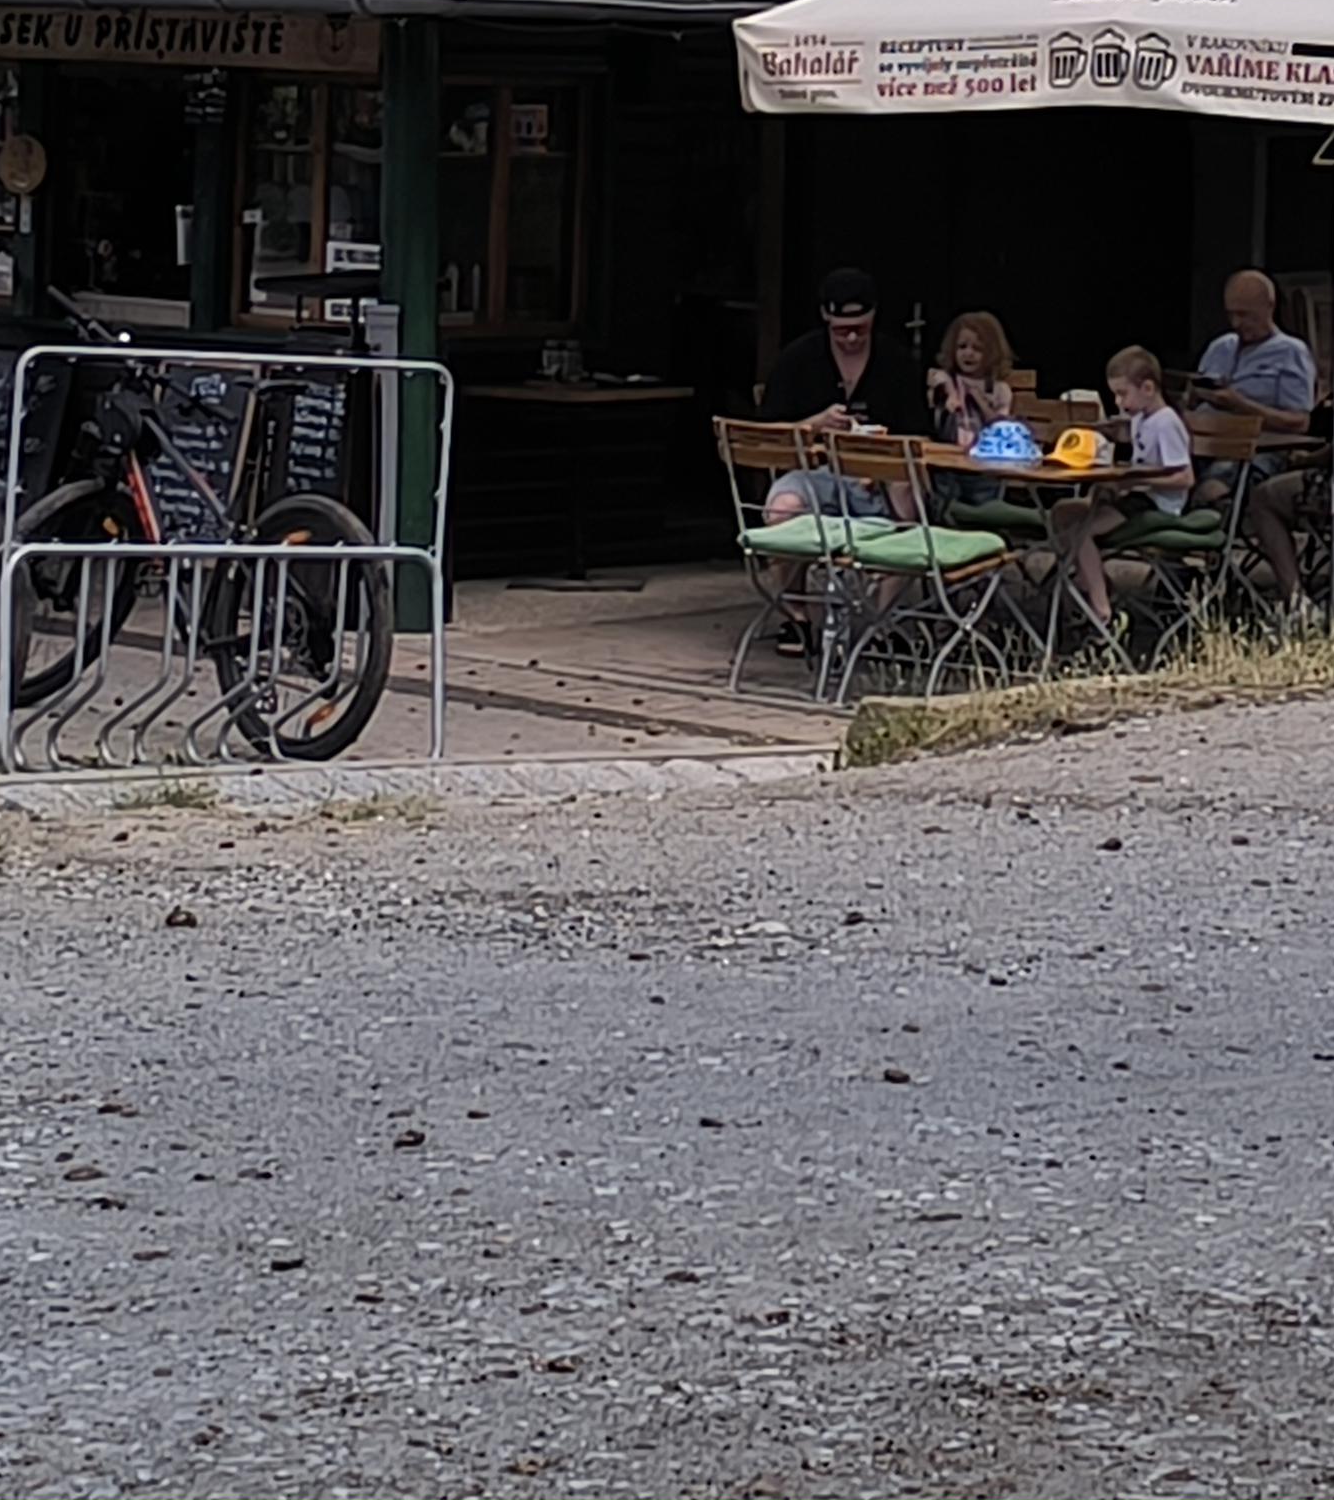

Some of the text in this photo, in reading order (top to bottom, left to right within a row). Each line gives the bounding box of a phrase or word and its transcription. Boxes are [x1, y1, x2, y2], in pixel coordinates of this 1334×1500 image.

[64, 14, 84, 47] U
[1185, 54, 1279, 81] VAŘÍME
[877, 72, 1037, 98] více než 500 let
